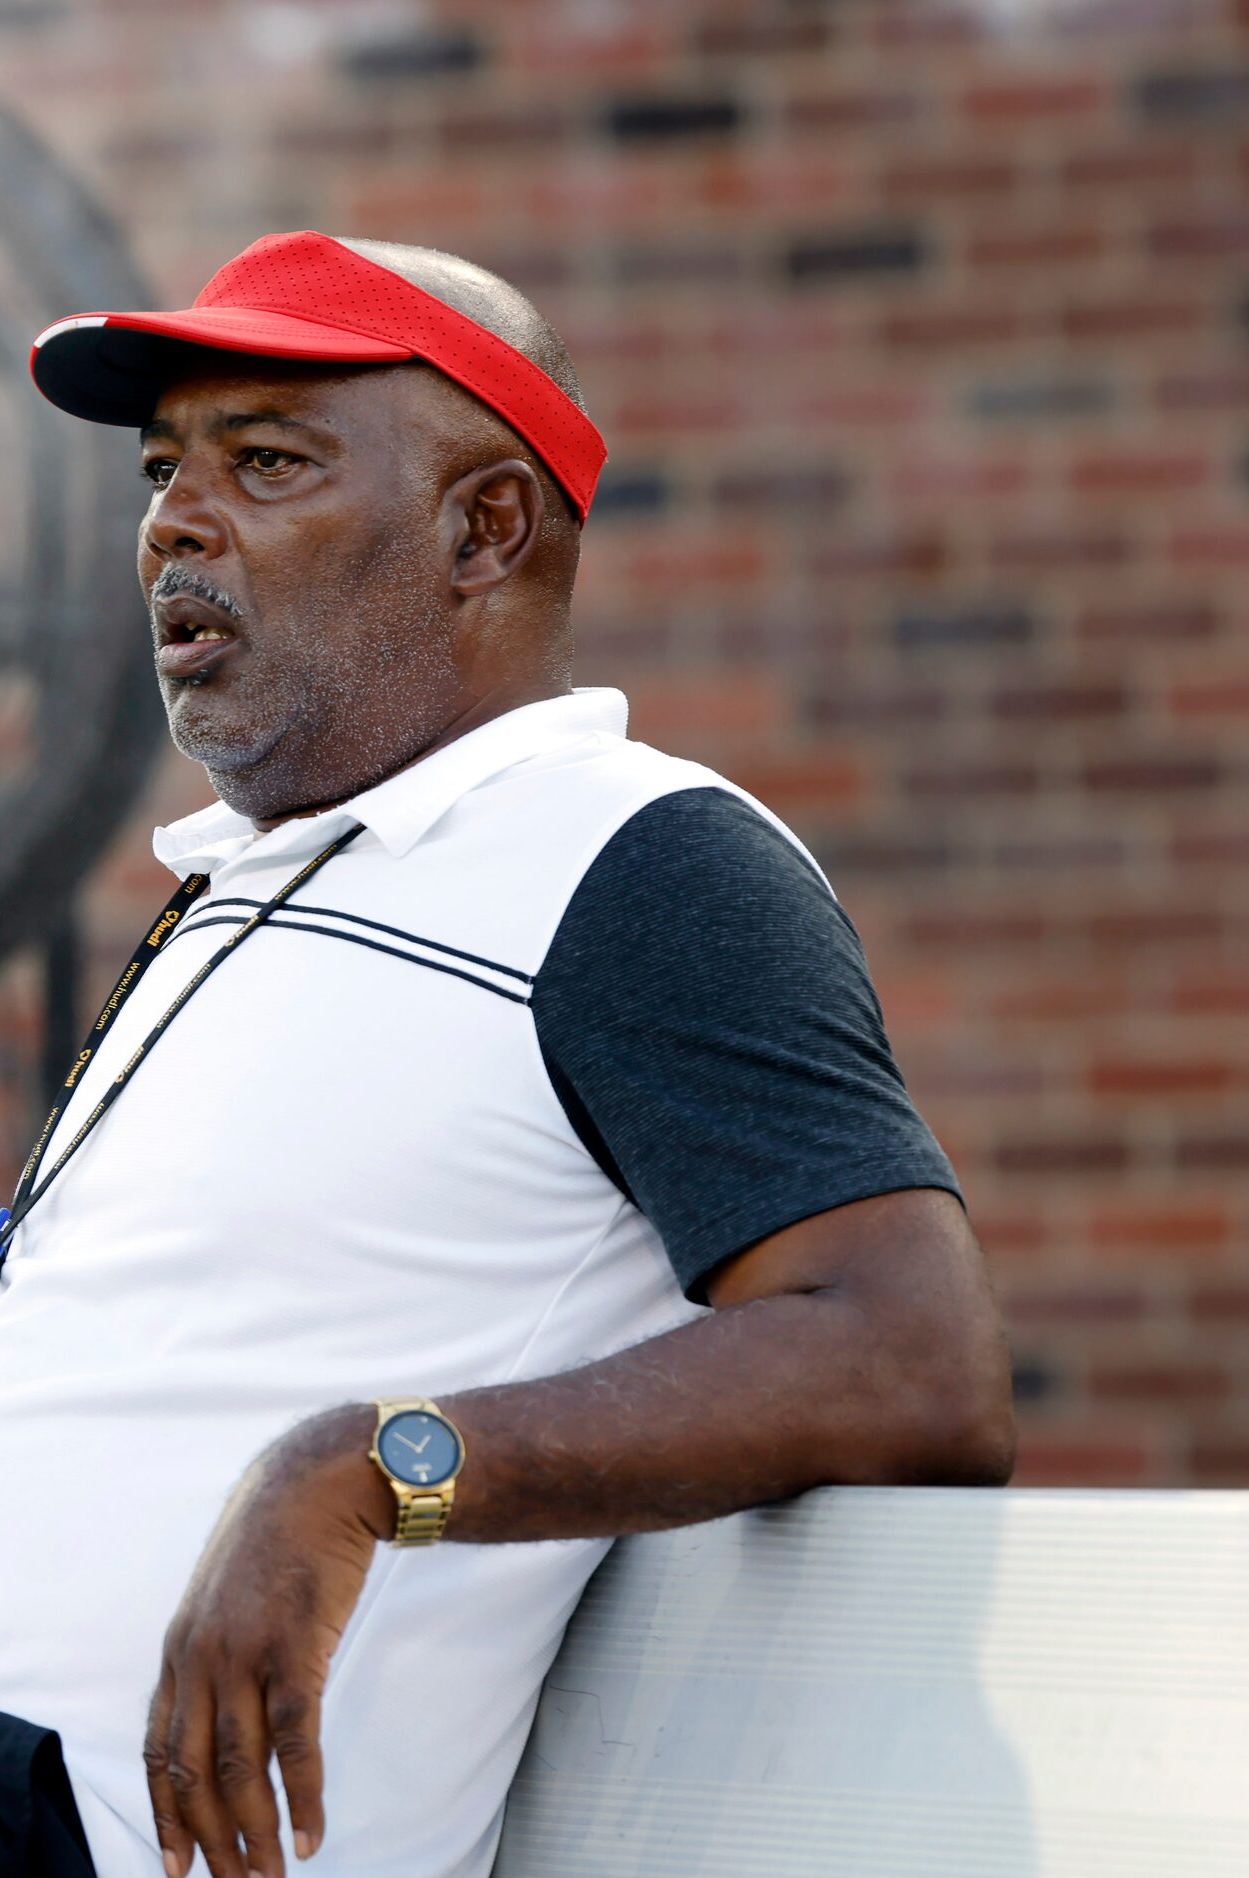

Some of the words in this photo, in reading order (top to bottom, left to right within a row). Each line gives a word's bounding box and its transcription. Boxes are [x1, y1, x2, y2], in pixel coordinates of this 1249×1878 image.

[146, 919, 172, 947] hudl
[95, 962, 140, 1030] www.hudl.com
[64, 1060, 85, 1088] hudl
